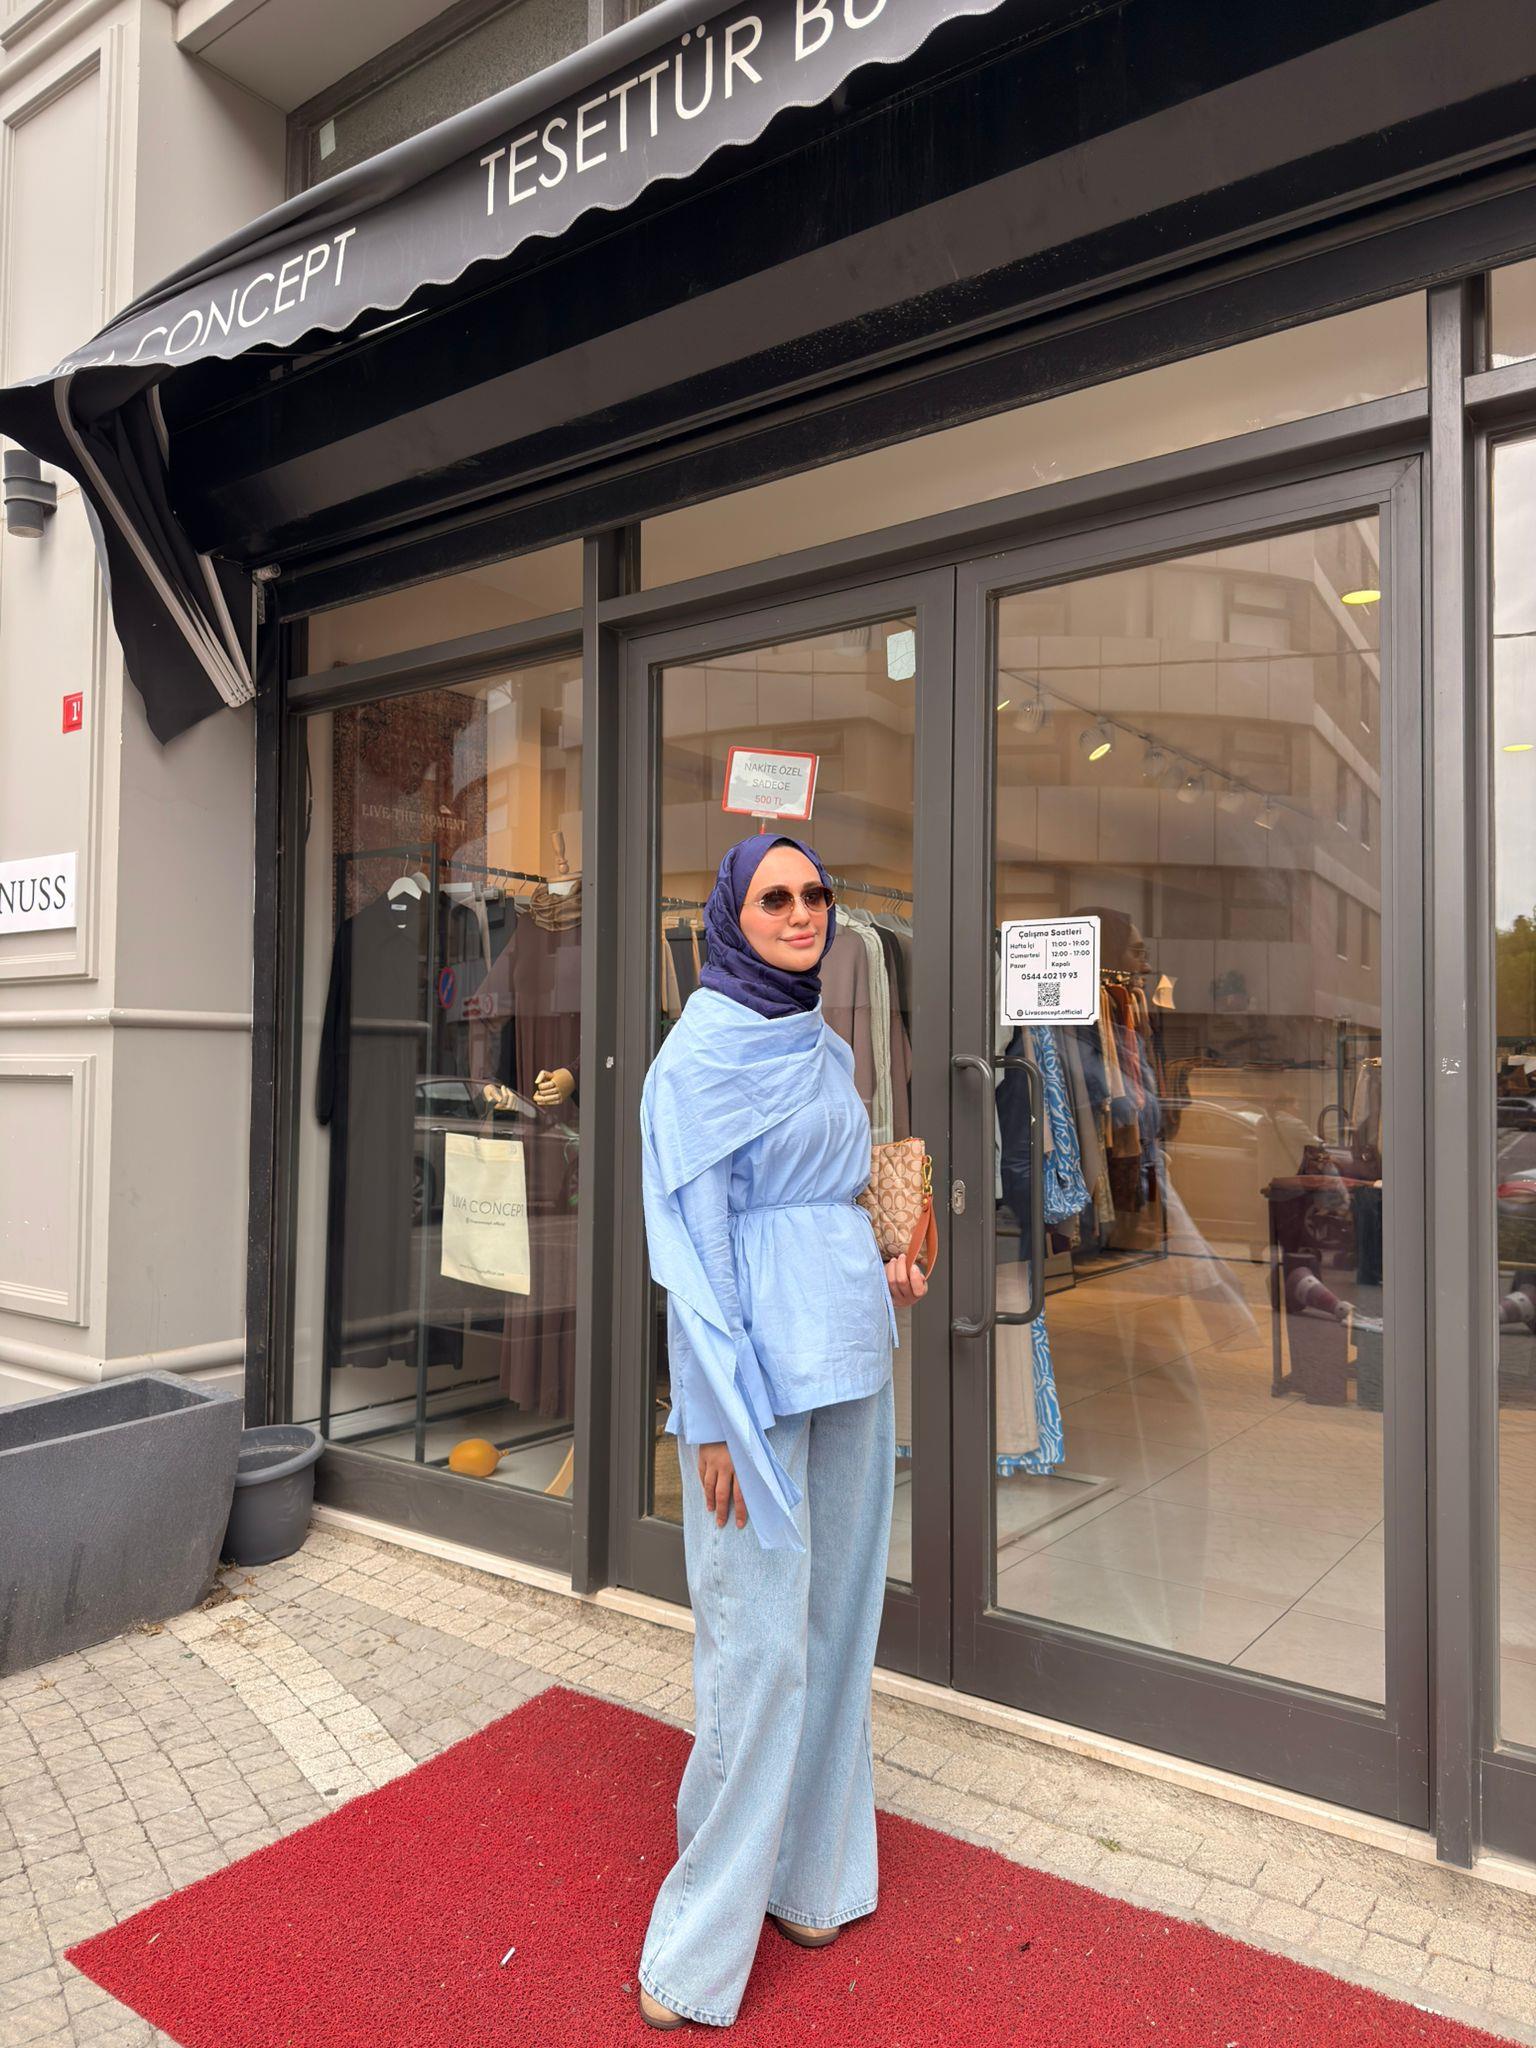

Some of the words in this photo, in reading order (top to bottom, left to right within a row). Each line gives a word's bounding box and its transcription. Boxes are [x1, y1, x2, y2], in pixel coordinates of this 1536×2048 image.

[127, 227, 356, 362] CONCEPT
[480, 15, 763, 215] TESETTÜR
[744, 762, 777, 774] NAKİTE
[779, 764, 803, 777] ÖZEL
[752, 778, 791, 791] SADECE
[755, 794, 772, 805] 500
[1019, 931, 1049, 939] Çalışma
[1050, 928, 1082, 936] Saatleri
